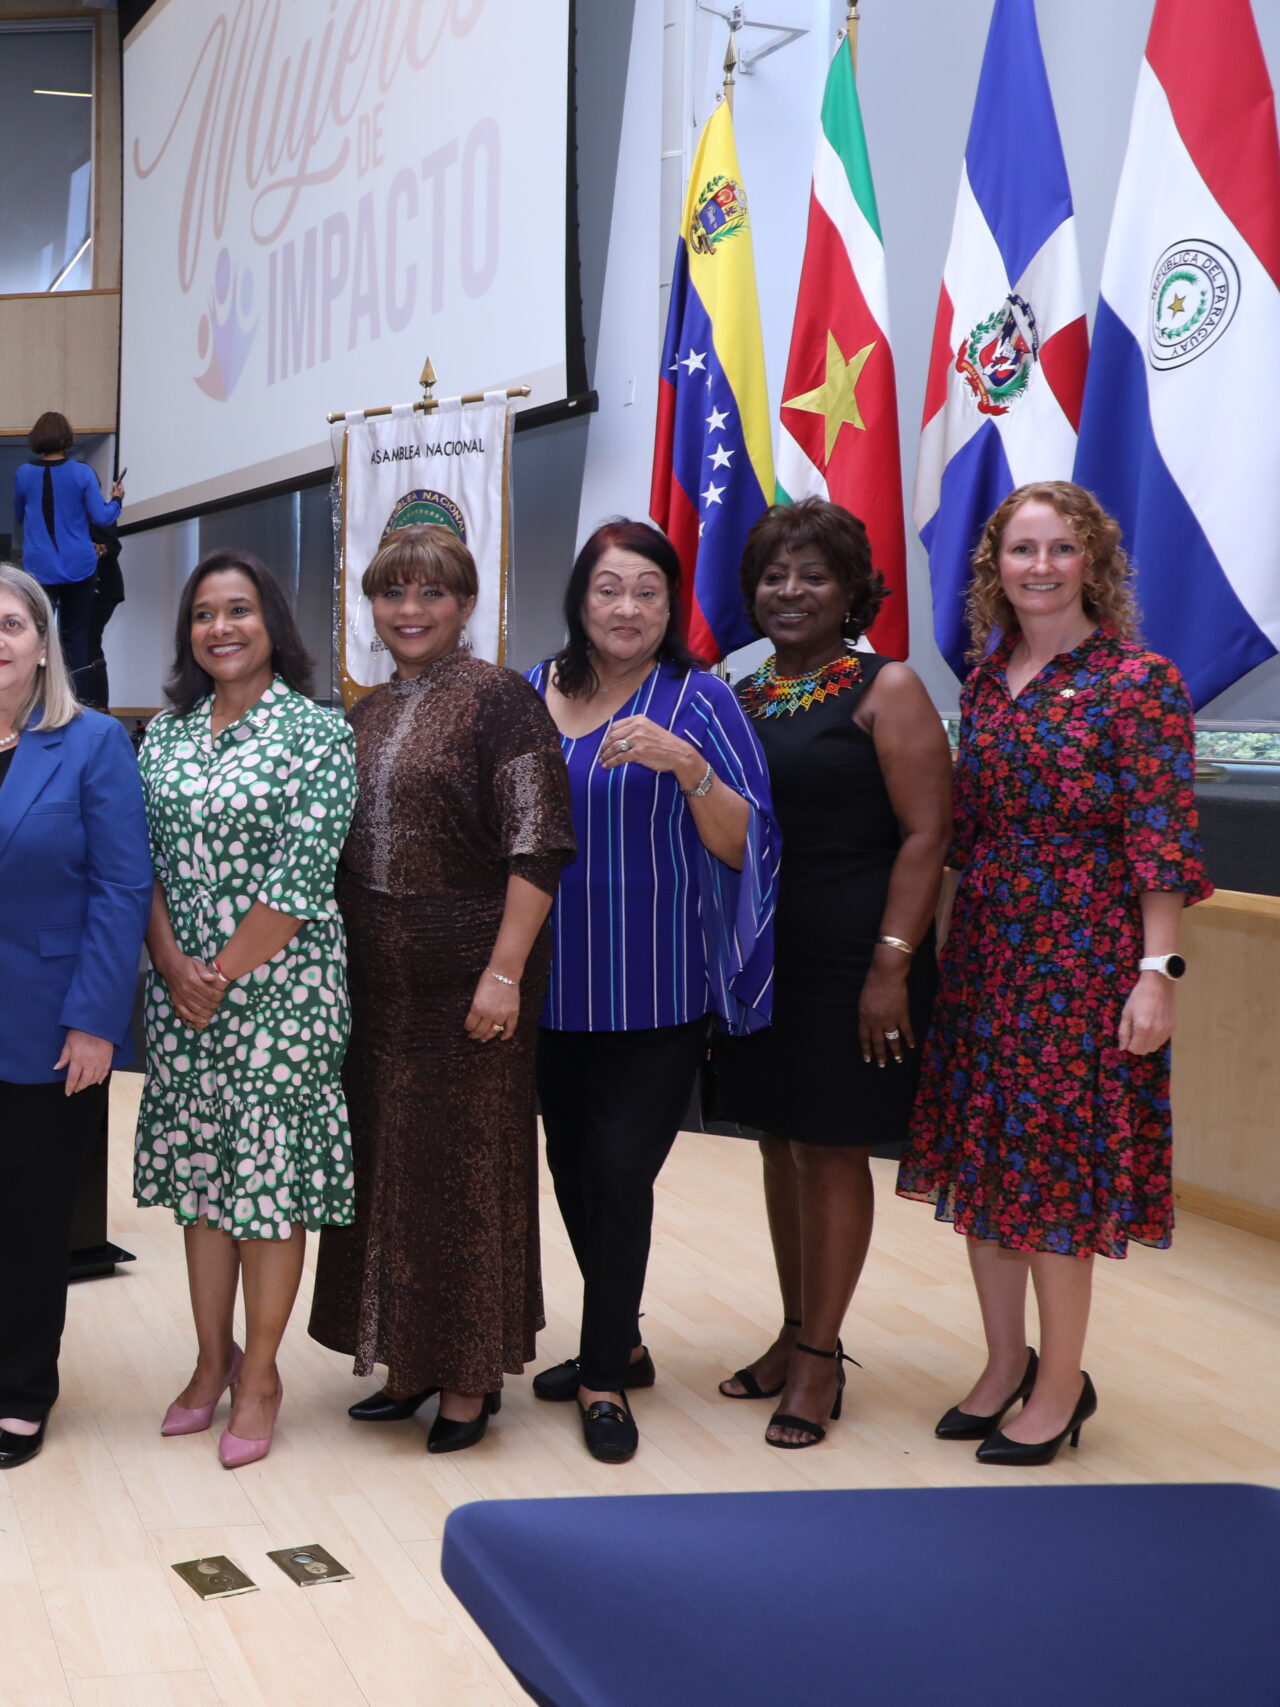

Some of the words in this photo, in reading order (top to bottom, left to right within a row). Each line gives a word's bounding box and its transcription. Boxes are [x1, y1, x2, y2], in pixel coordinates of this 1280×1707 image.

[357, 101, 385, 179] DE
[267, 117, 501, 387] IMPACTO
[1201, 258, 1222, 282] DEL
[1171, 284, 1226, 357] PARAGUAY
[370, 445, 420, 465] ASAMBLEA
[426, 438, 484, 457] NACIONAL
[422, 491, 465, 532] NACIONAL
